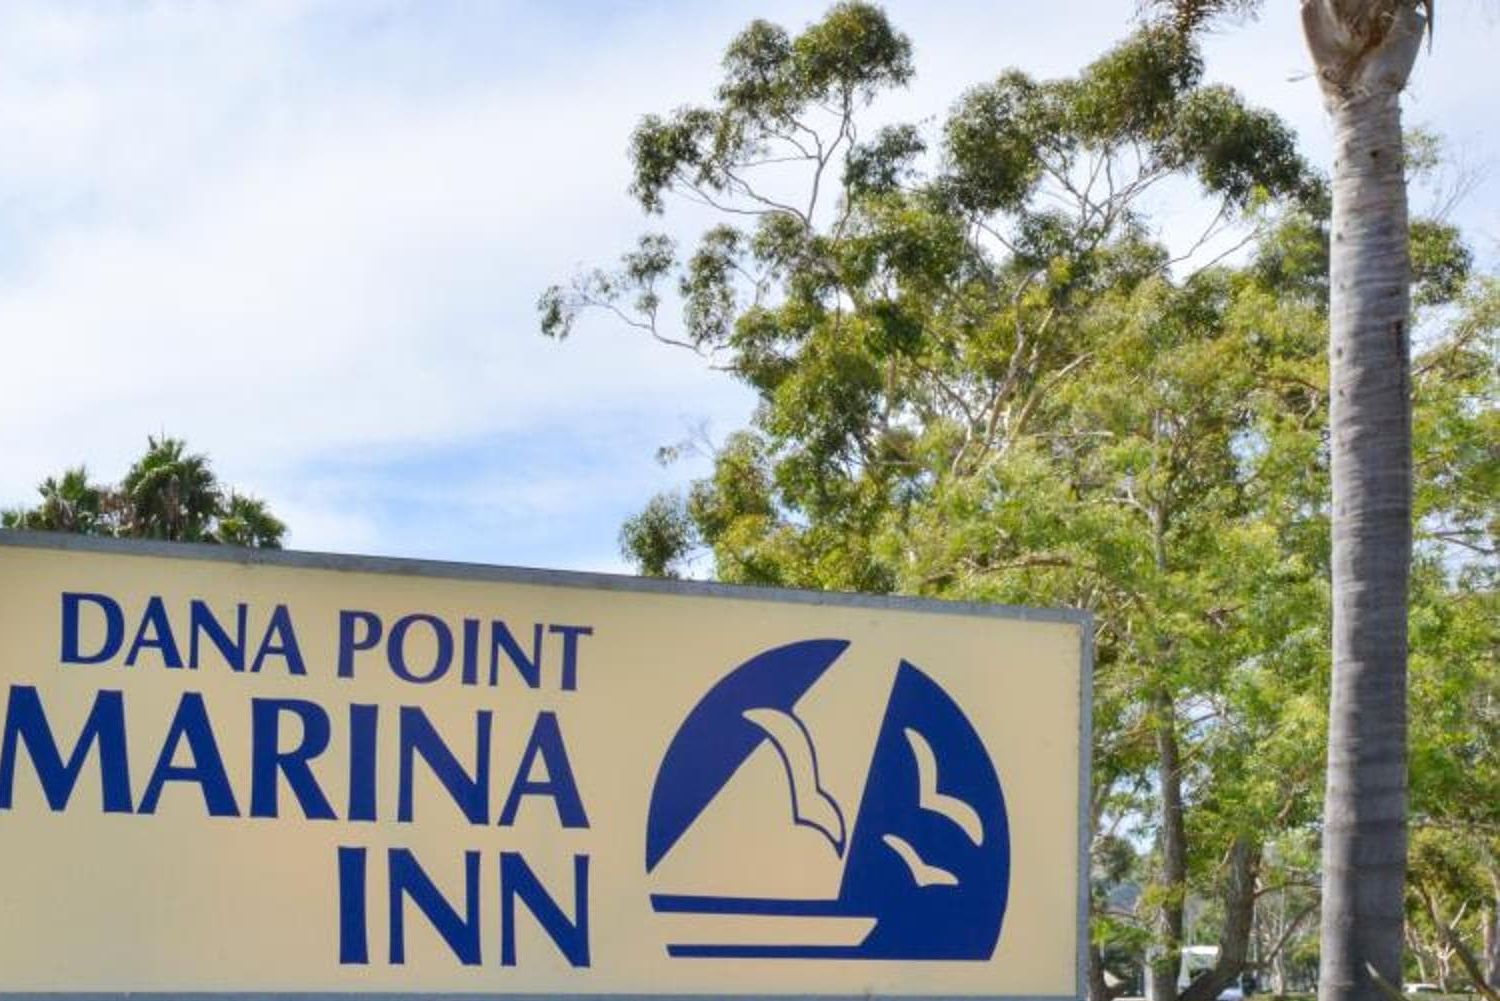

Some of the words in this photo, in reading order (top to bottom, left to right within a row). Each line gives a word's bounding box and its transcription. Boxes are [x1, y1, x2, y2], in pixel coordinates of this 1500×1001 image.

[61, 592, 306, 677] DANA
[338, 610, 594, 691] POINT
[338, 846, 591, 968] INN
